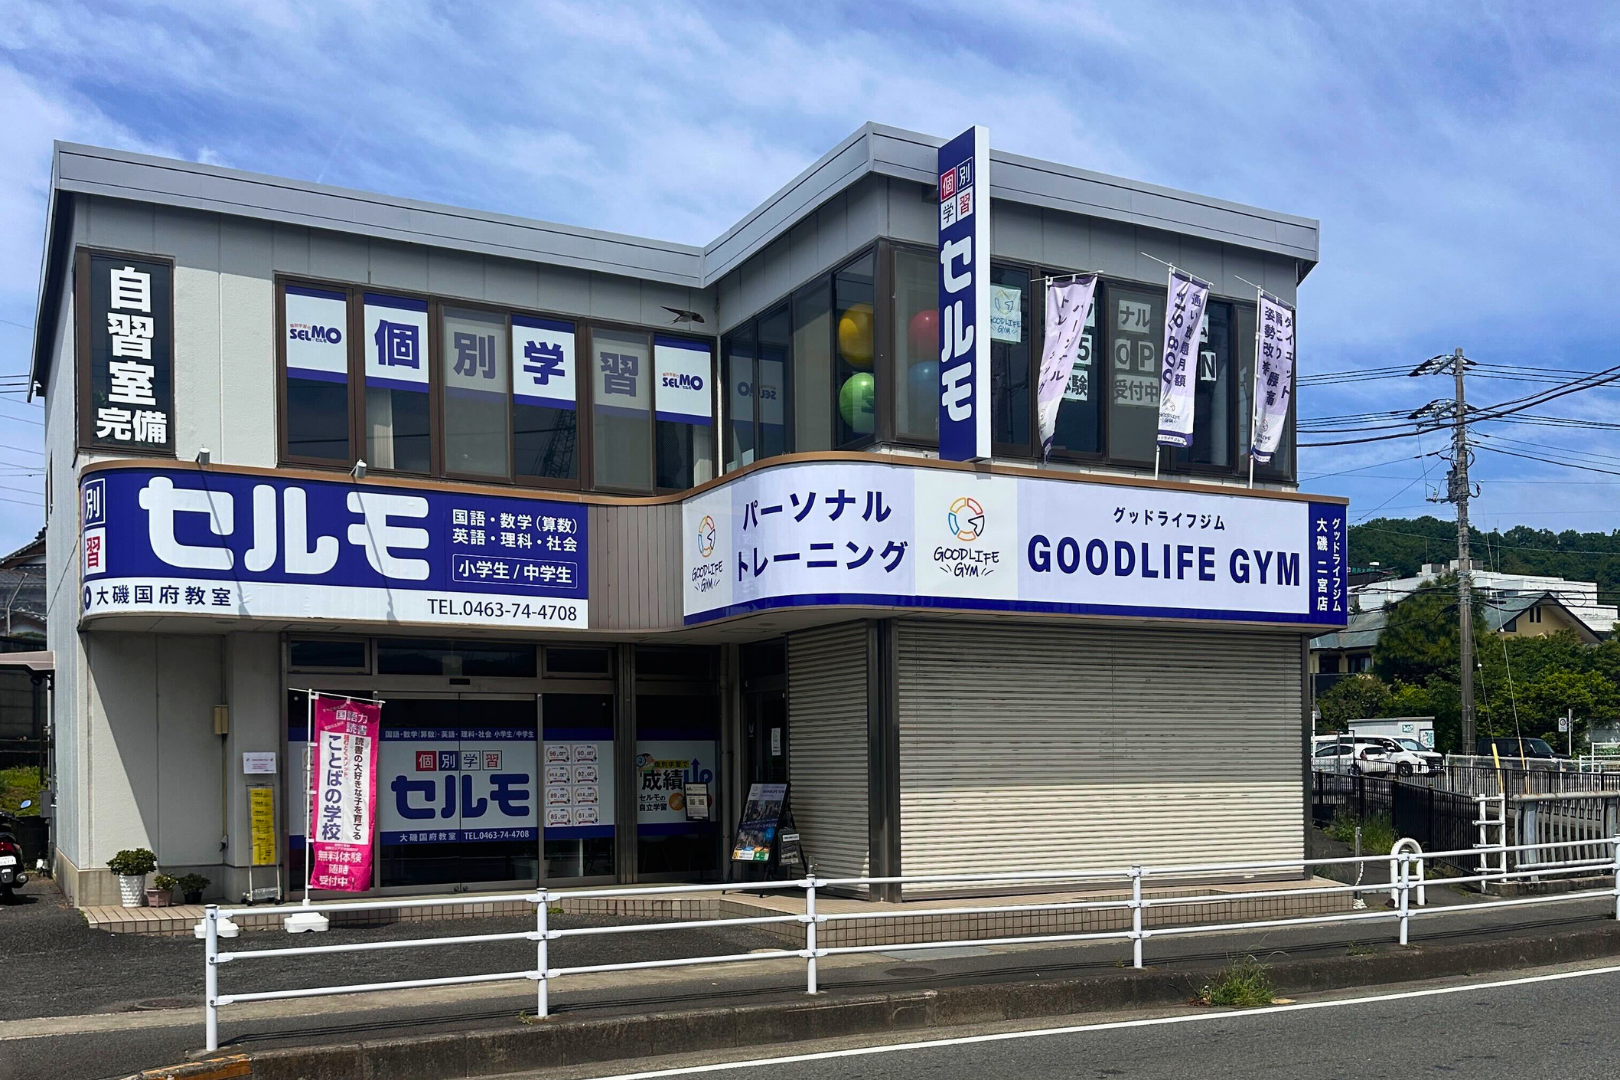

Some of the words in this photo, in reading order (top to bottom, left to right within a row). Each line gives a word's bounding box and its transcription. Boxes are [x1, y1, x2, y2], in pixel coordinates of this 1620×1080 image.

[107, 266, 156, 406] 自習室
[290, 325, 342, 344] SELMO
[940, 235, 974, 422] セルモ
[663, 374, 703, 390] SELMO
[1114, 379, 1159, 401] 受付中
[96, 407, 168, 444] 完備
[742, 488, 891, 531] パーソナル
[1113, 506, 1225, 531] グッドライフジム
[138, 476, 430, 581] セルモ
[452, 528, 578, 552] 英語・理科・社会
[738, 540, 909, 581] トレーニング
[933, 546, 1000, 566] GOODLIFE
[1027, 534, 1216, 582] GOODLIFE
[1229, 548, 1300, 586] GYM
[1332, 518, 1342, 612] グッドライフジム
[691, 560, 723, 582] GOODLIFE
[954, 561, 979, 577] GYM
[96, 584, 231, 607] 大磯国府教室
[700, 578, 714, 593] GYM
[427, 598, 578, 621] TEL.0463-74-4708
[336, 709, 368, 724] 国語力
[418, 753, 499, 769] 個別学習
[322, 735, 344, 841] ことばの学校
[353, 737, 365, 841] 読書の大好きな子を育てる
[391, 774, 530, 819] セルモ
[639, 793, 666, 802] セルモの
[639, 803, 668, 812] 自立学習
[400, 832, 457, 843] 大磯国府教室
[464, 830, 530, 840] TEL.0463-74-4708
[317, 850, 362, 863] 無料体験
